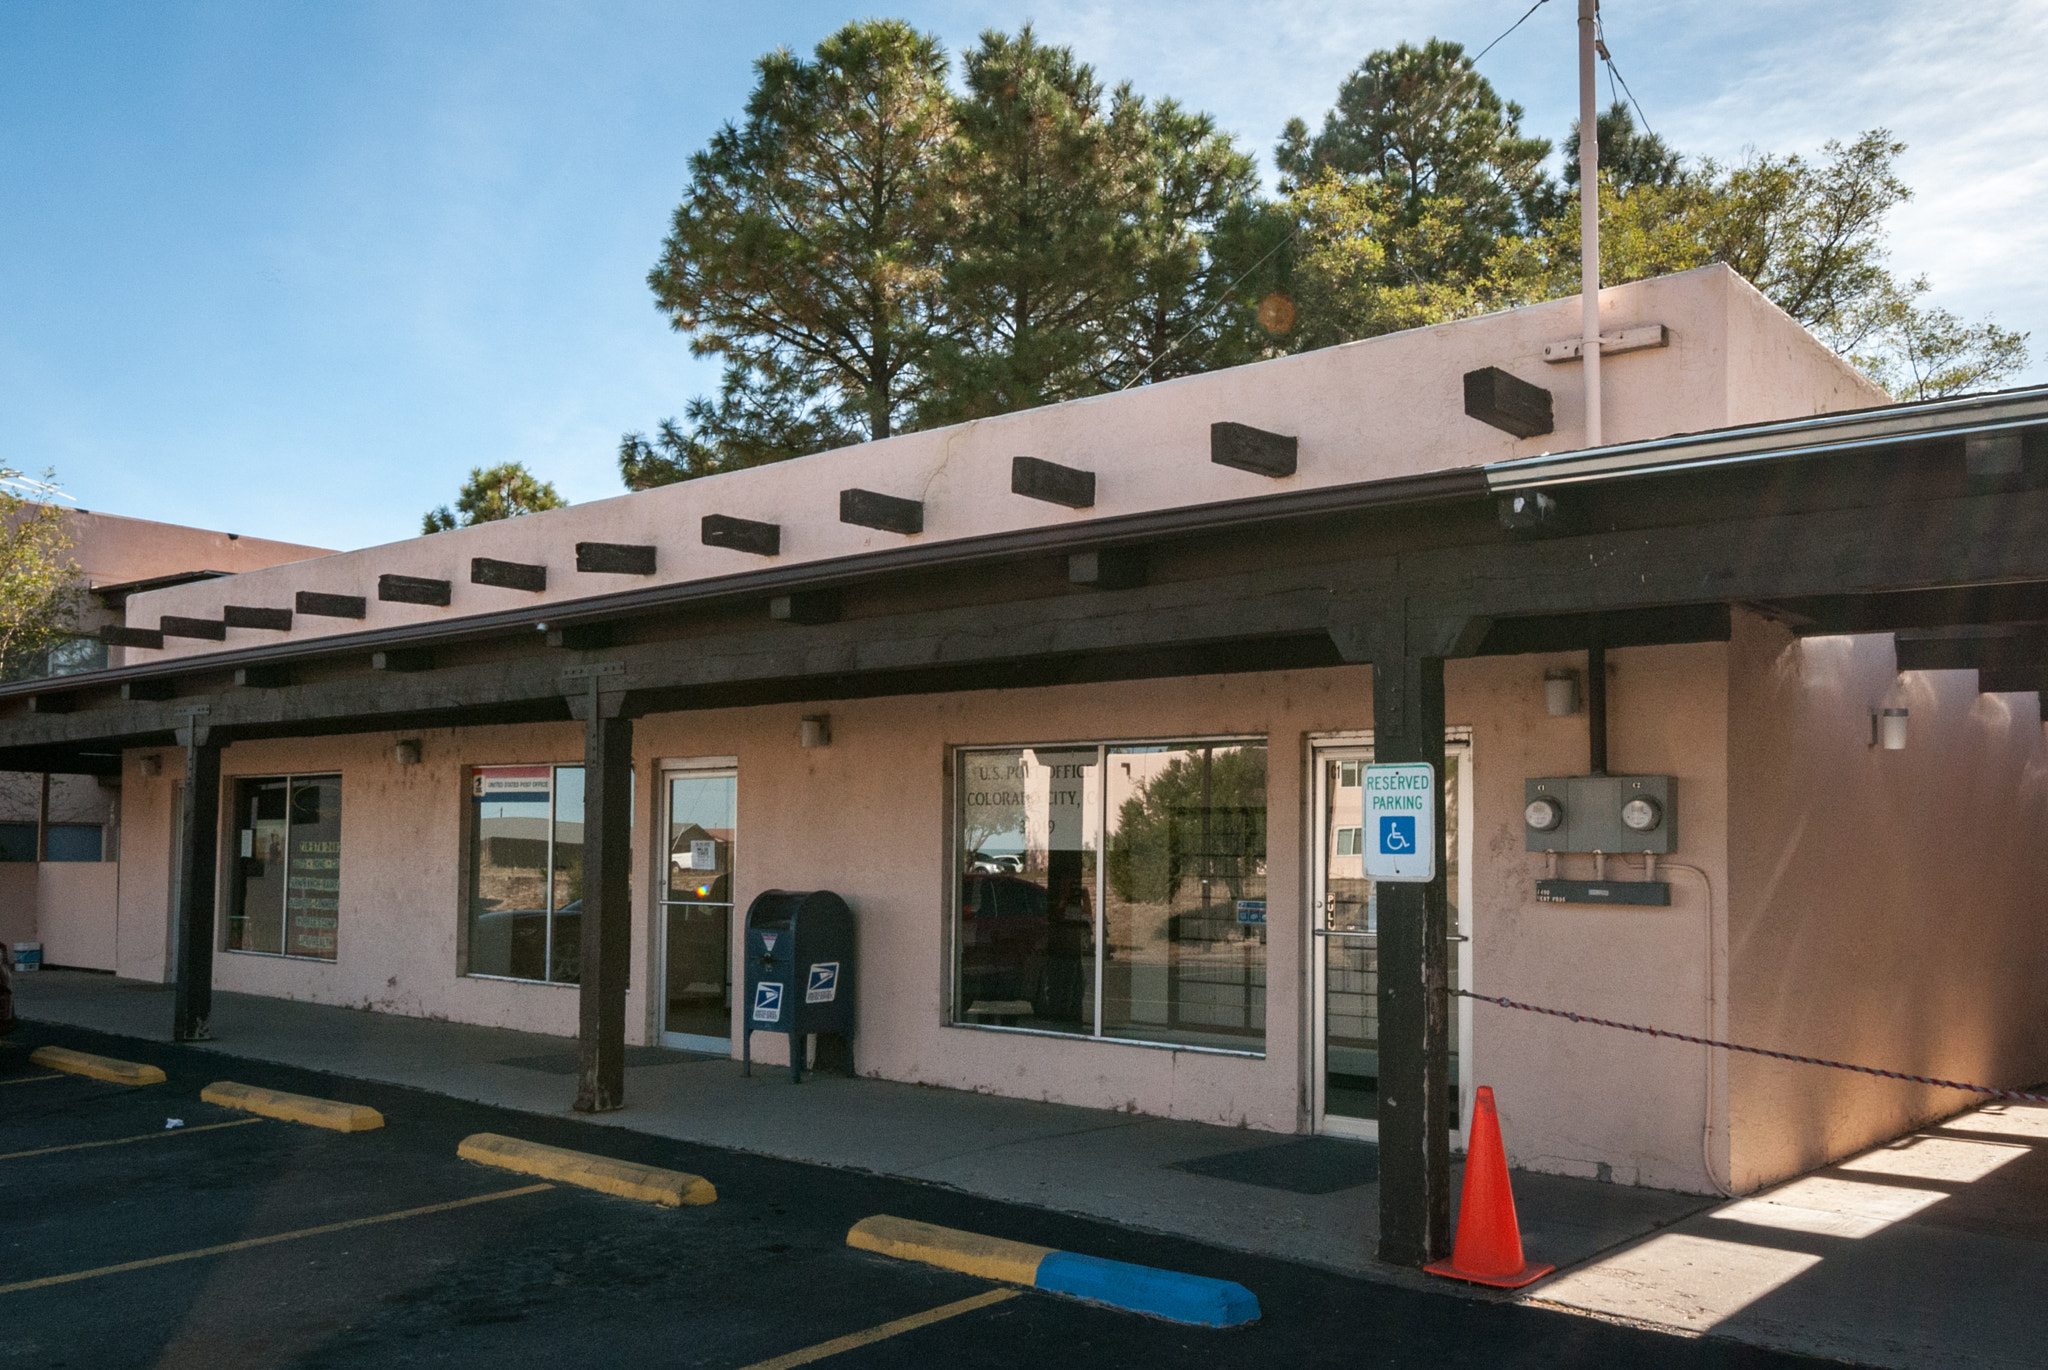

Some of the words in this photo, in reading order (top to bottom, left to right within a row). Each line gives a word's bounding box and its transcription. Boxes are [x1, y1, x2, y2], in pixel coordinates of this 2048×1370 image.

[980, 766, 1003, 780] U.S.
[1007, 764, 1040, 779] PO
[1367, 775, 1429, 790] RESERVED
[967, 791, 1041, 807] COLORA
[1373, 796, 1423, 810] PARKING
